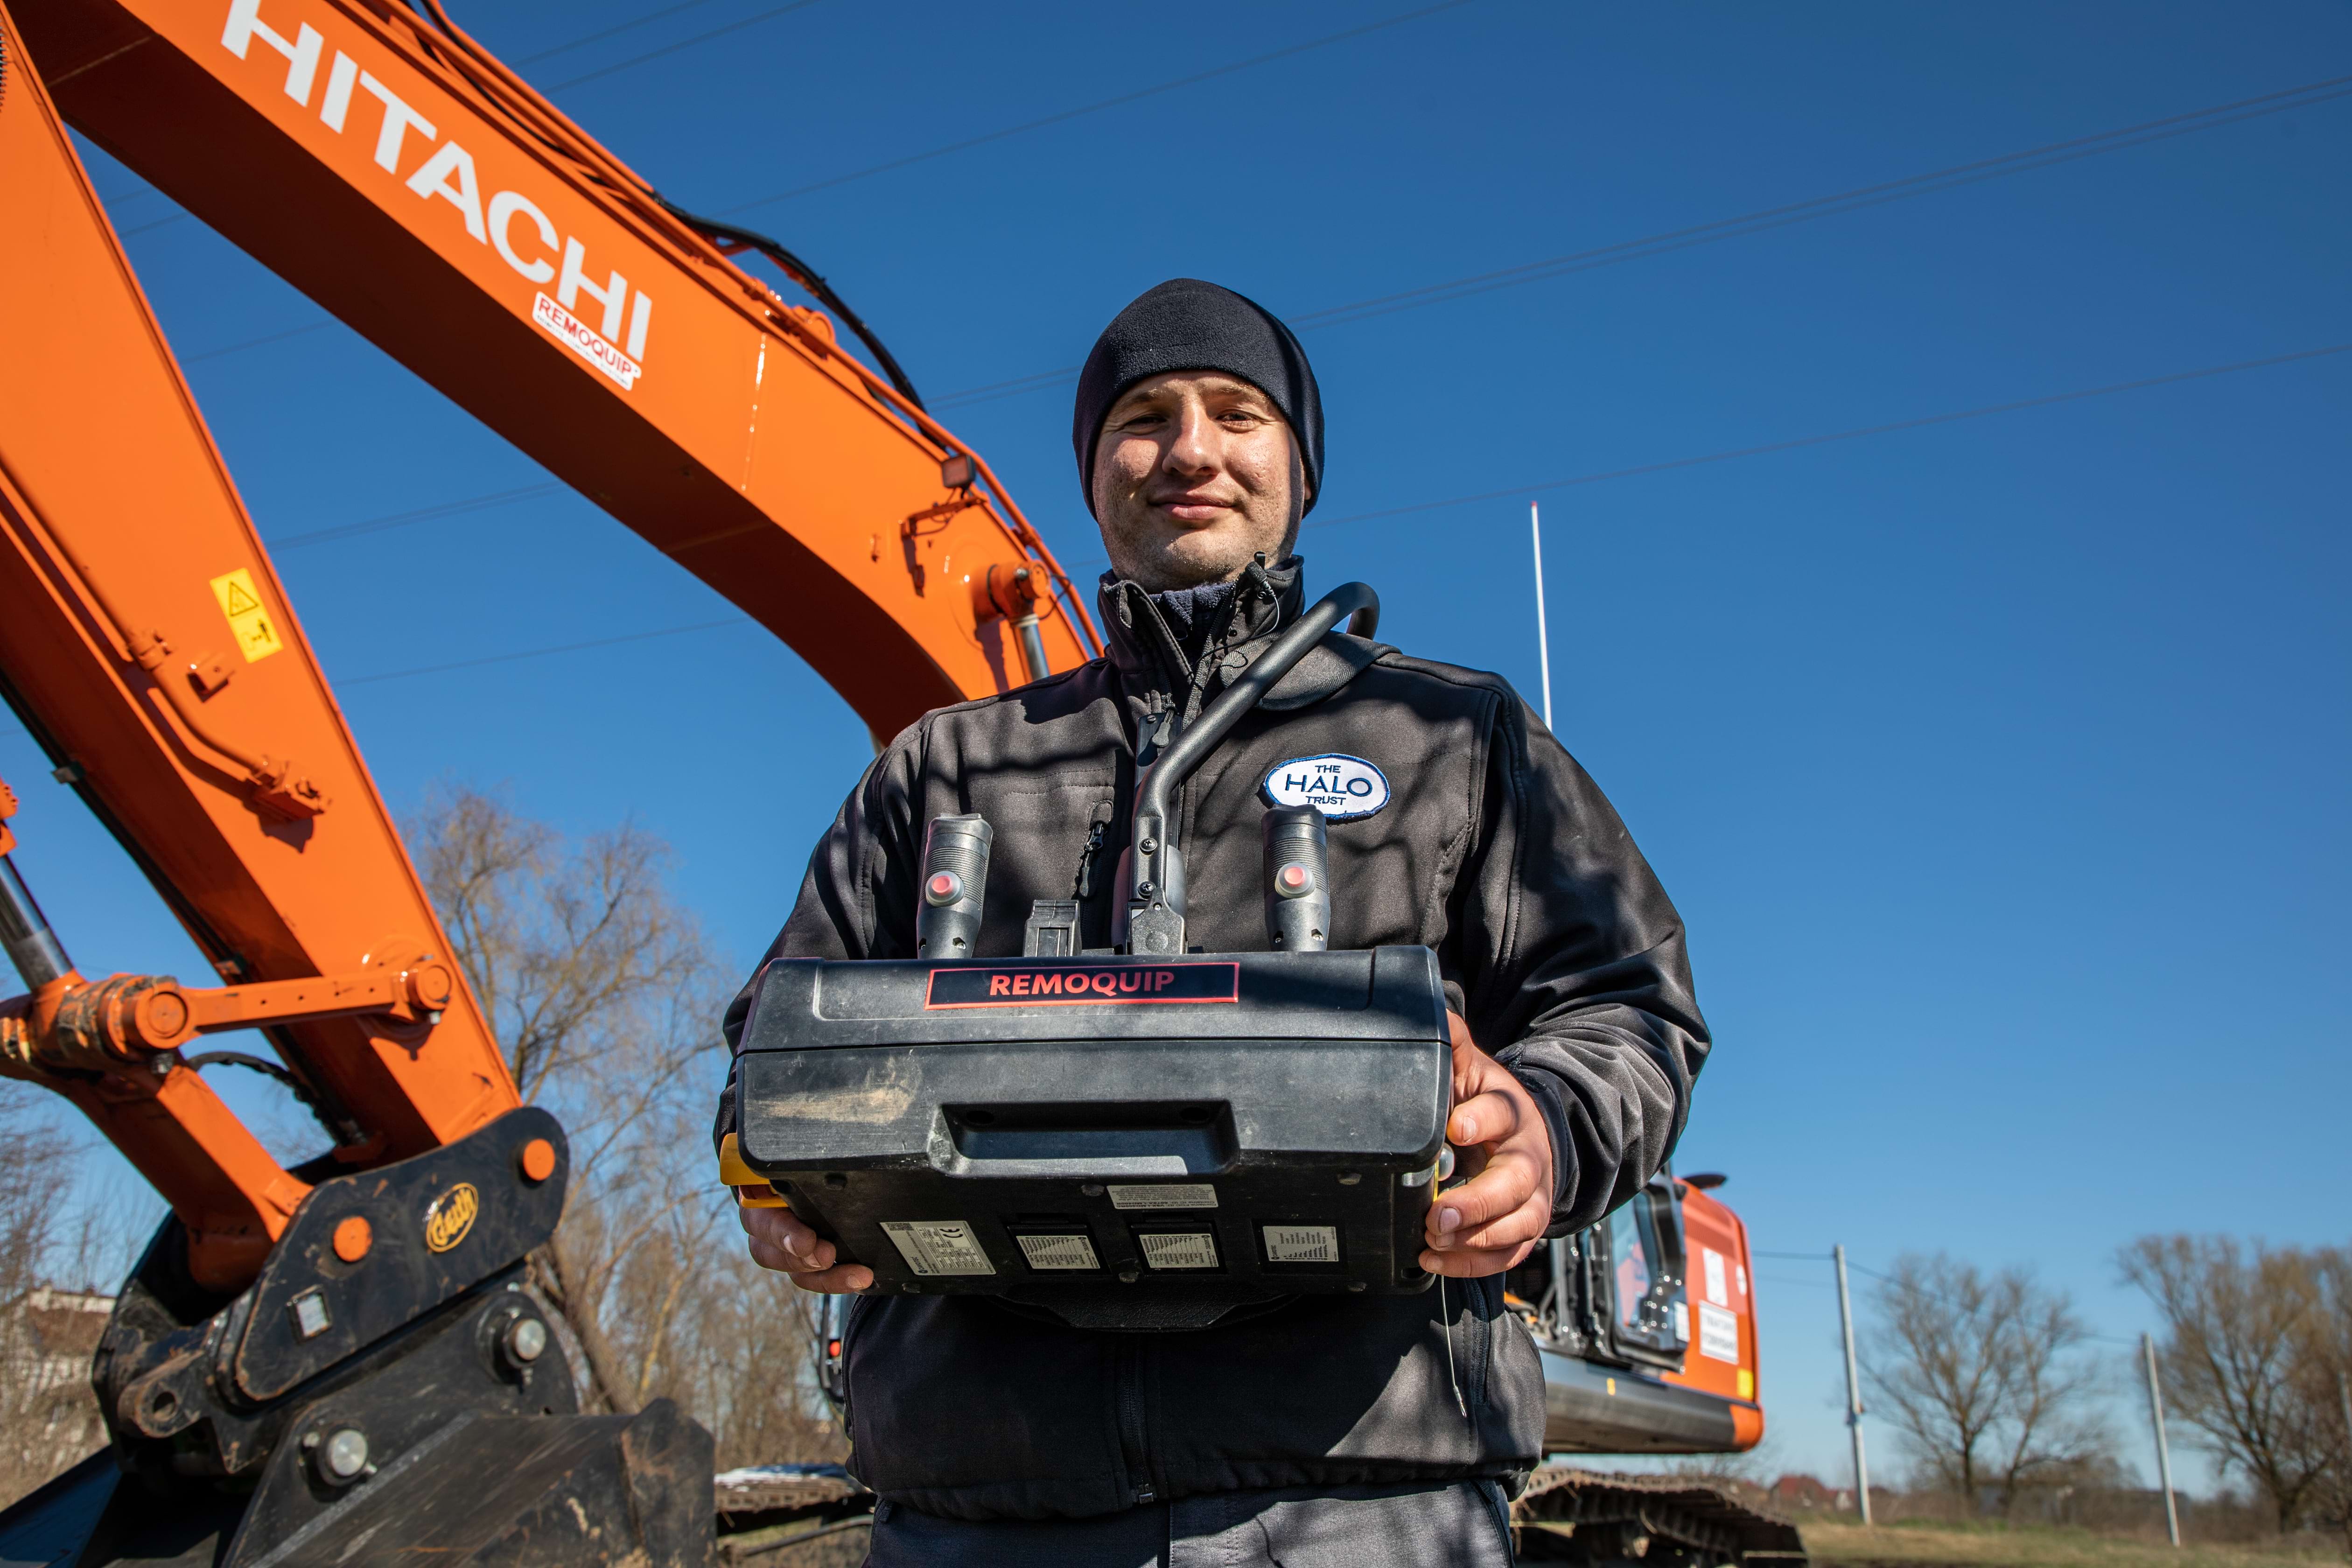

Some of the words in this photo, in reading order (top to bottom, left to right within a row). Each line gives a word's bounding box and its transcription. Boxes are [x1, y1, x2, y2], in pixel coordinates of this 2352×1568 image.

[220, 0, 652, 363] HITACHI
[539, 297, 632, 374] REMOQUIP
[1315, 765, 1341, 773] THE
[1285, 774, 1373, 797] HALO
[1305, 796, 1346, 805] TRUST
[990, 971, 1175, 997] REMOQUIP
[910, 1256, 924, 1270] CAVOTEC
